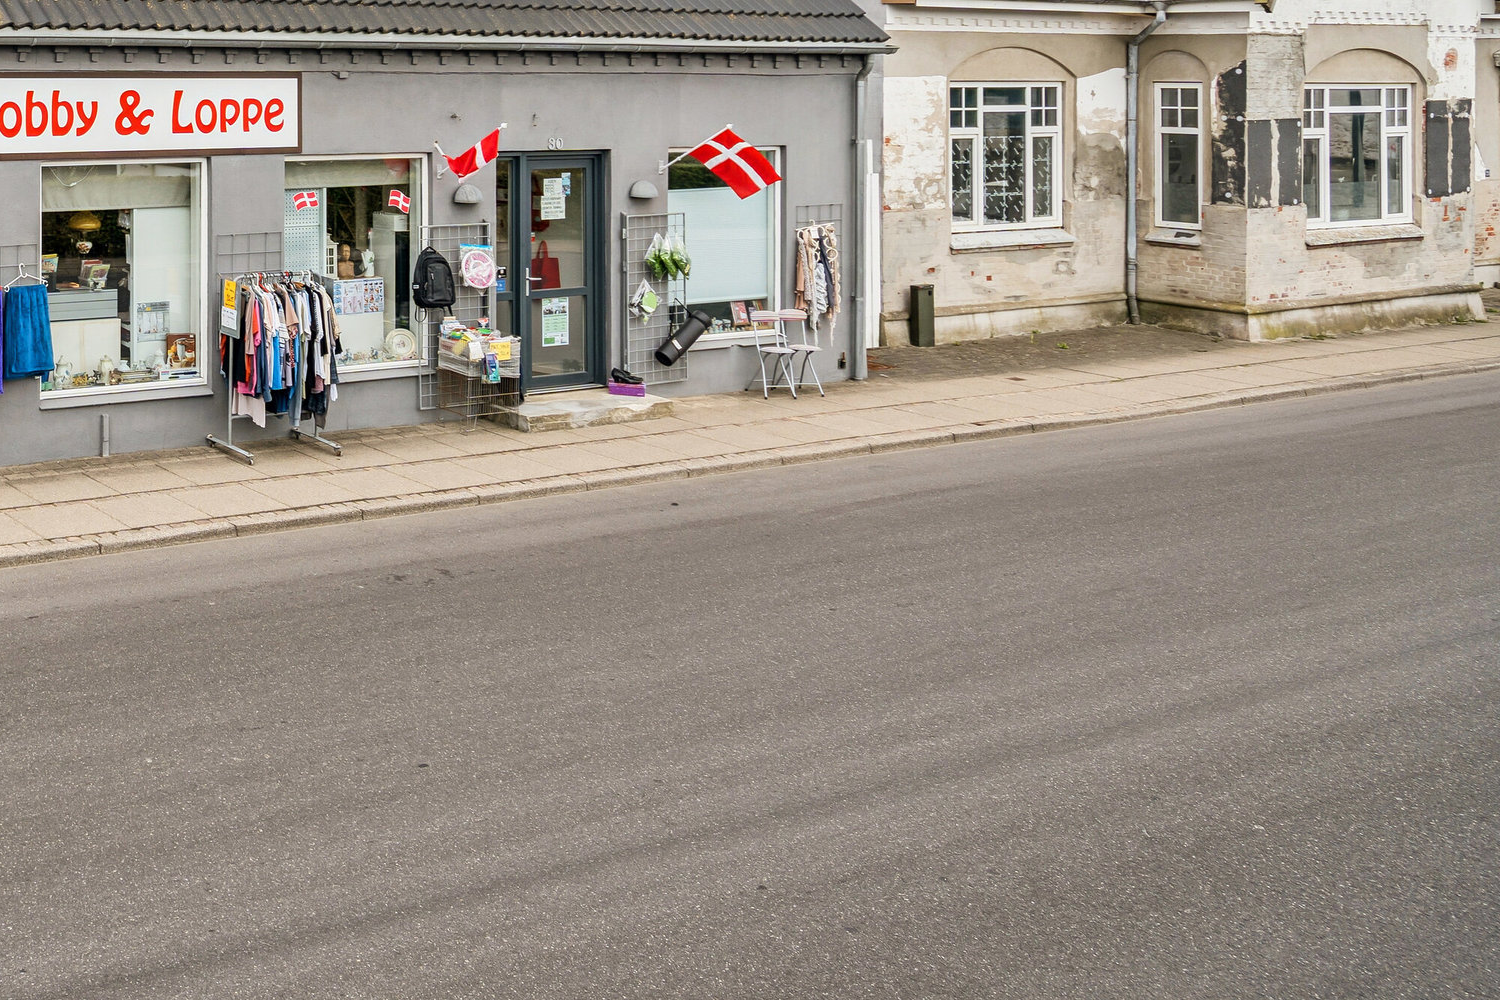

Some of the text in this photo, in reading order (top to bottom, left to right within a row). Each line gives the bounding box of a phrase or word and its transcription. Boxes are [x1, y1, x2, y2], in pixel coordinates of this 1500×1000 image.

[114, 89, 155, 136] &
[171, 90, 285, 134] Loppe
[548, 137, 564, 150] 30
